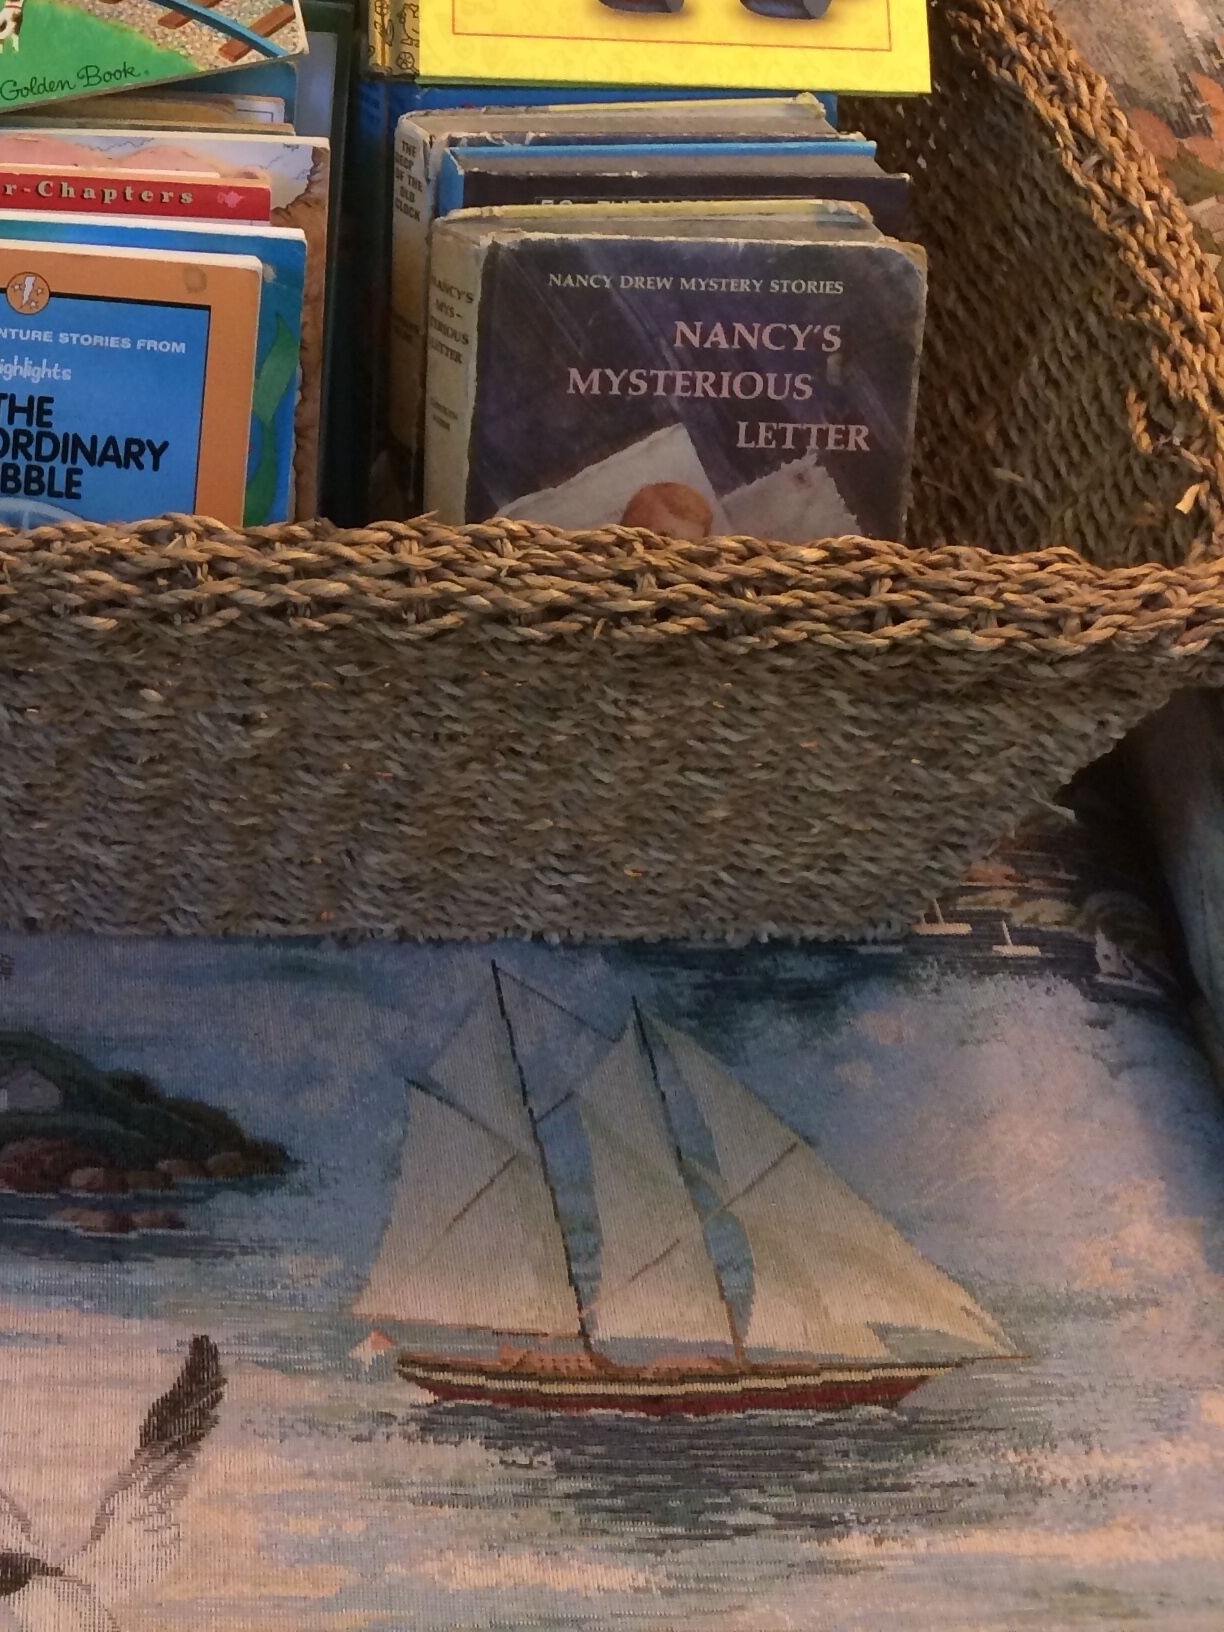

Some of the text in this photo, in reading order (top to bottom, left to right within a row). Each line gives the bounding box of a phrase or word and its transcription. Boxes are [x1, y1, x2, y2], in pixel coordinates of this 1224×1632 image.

[0, 77, 76, 102] Golden
[77, 62, 142, 88] Book
[549, 273, 845, 295] NANCY DREW MYSTERY STORIES
[58, 332, 132, 350] STORIES
[136, 339, 187, 354] FROM
[674, 320, 842, 353] NANCY'S
[566, 368, 815, 401] MYSTERIOUS
[736, 421, 871, 451] LETTER
